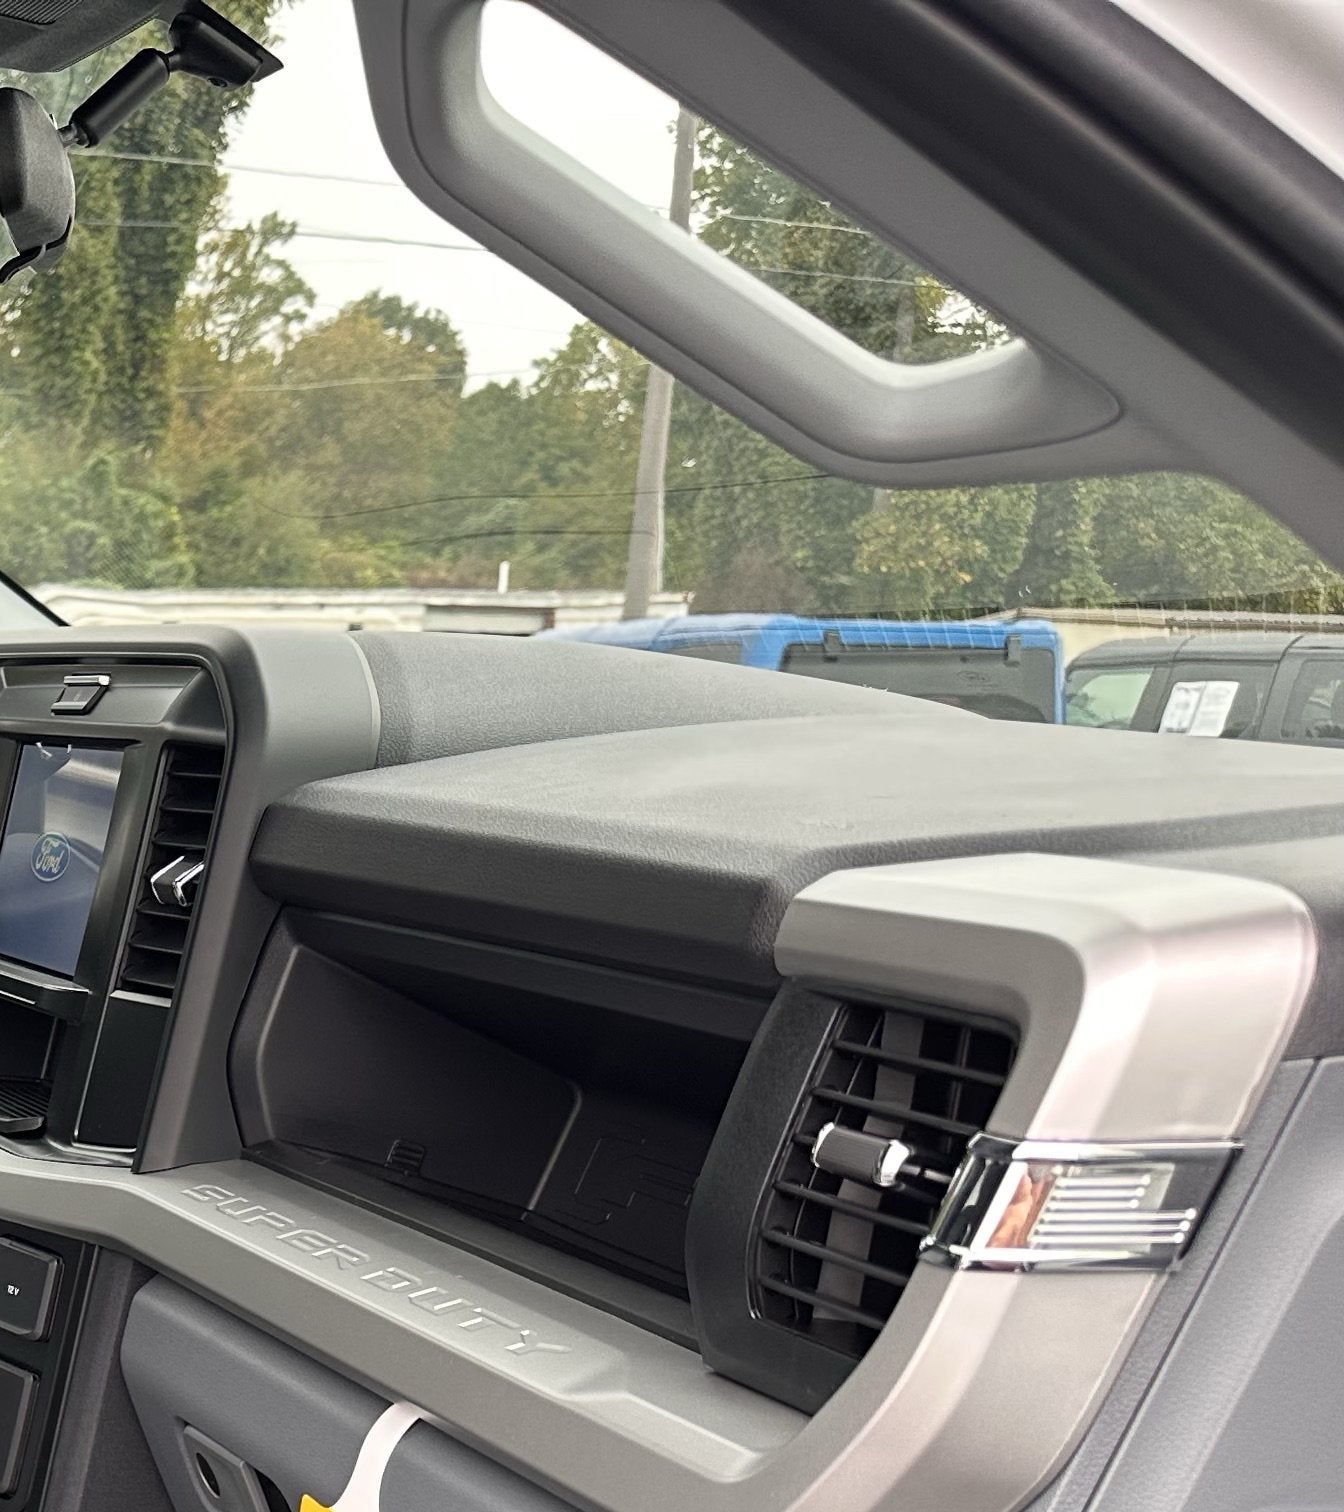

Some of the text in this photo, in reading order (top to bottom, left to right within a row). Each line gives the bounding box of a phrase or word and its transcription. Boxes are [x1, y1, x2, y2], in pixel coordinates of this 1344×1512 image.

[35, 838, 65, 874] Ford
[180, 1183, 572, 1355] SUPER DUTY
